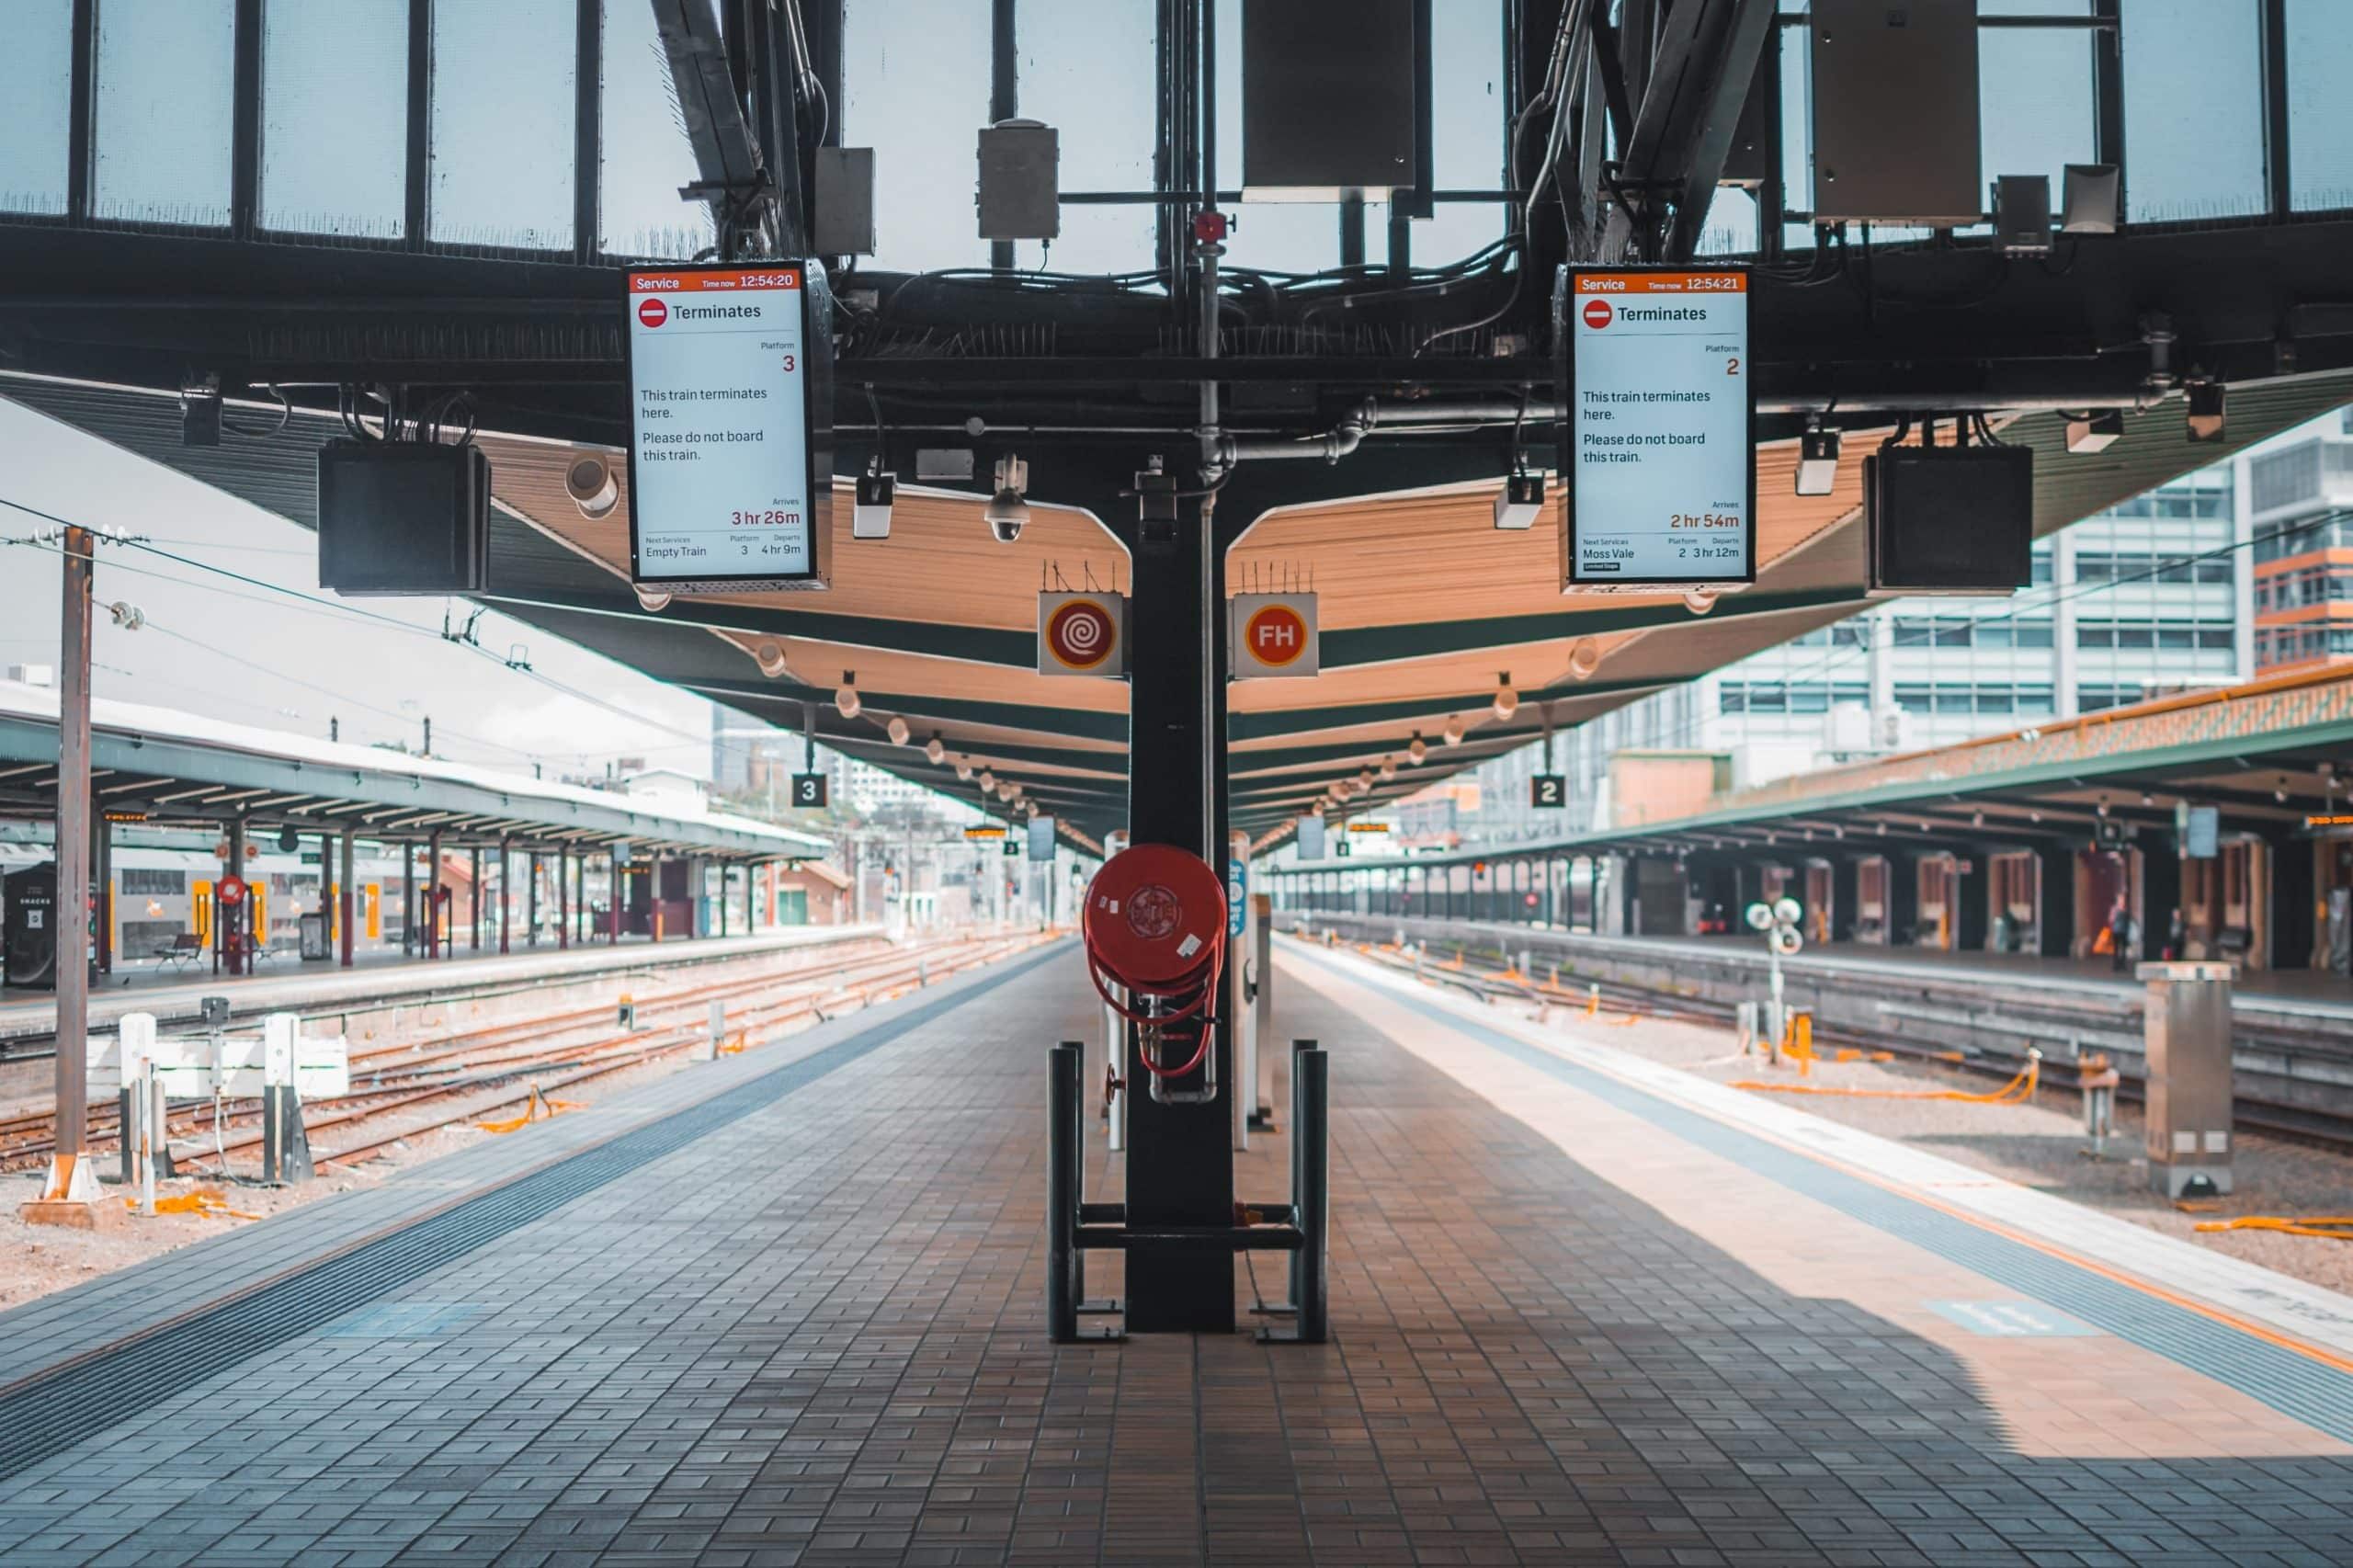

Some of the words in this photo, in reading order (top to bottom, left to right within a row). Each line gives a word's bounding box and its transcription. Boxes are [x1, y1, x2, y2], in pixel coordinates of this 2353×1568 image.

[636, 278, 680, 290] Service
[740, 274, 794, 287] 12:54:20
[1582, 278, 1625, 290] Service
[1686, 278, 1738, 290] 12:54:21
[673, 304, 761, 320] Terminates
[1618, 306, 1707, 321] Terminates
[760, 342, 795, 350] Platform
[1705, 345, 1740, 353] Platform
[783, 355, 795, 372] 3
[1726, 358, 1740, 375] 2
[642, 390, 667, 402] This
[668, 388, 698, 401] train
[700, 387, 767, 400] terminates
[1583, 391, 1608, 403] This
[1610, 391, 1641, 403] train
[1643, 390, 1711, 402] terminates
[642, 407, 674, 419] here.
[1584, 408, 1615, 420] here.
[642, 432, 683, 444] Please
[685, 431, 701, 443] do
[703, 431, 725, 442] not
[727, 429, 764, 442] board
[1584, 434, 1624, 445] Please
[1626, 433, 1643, 445] do
[1645, 434, 1667, 445] not
[1668, 433, 1705, 445] board
[643, 449, 666, 461] this
[668, 449, 701, 461] train.
[1584, 451, 1607, 462] this
[1609, 451, 1642, 462] train.
[732, 512, 742, 526] 3
[745, 512, 761, 525] hr
[764, 511, 800, 525] 26m
[1670, 515, 1680, 528] 2
[1684, 515, 1700, 528] hr
[1703, 515, 1739, 528] 54m
[663, 536, 690, 544] Services
[773, 534, 801, 542] Departs
[1711, 537, 1739, 545] Departs
[646, 548, 678, 559] Empty
[682, 546, 707, 556] Train
[741, 546, 748, 555] 3
[761, 544, 768, 554] 4
[770, 544, 781, 554] hr
[783, 544, 801, 554] 9m
[1583, 549, 1610, 559] Moss
[1612, 549, 1634, 559] Vale
[1678, 548, 1686, 558] 2
[1693, 548, 1700, 558] 3
[1702, 548, 1713, 558] hr
[1716, 548, 1739, 558] 12m
[1257, 624, 1294, 647] FH
[801, 780, 816, 801] 3
[1541, 781, 1557, 801] 2
